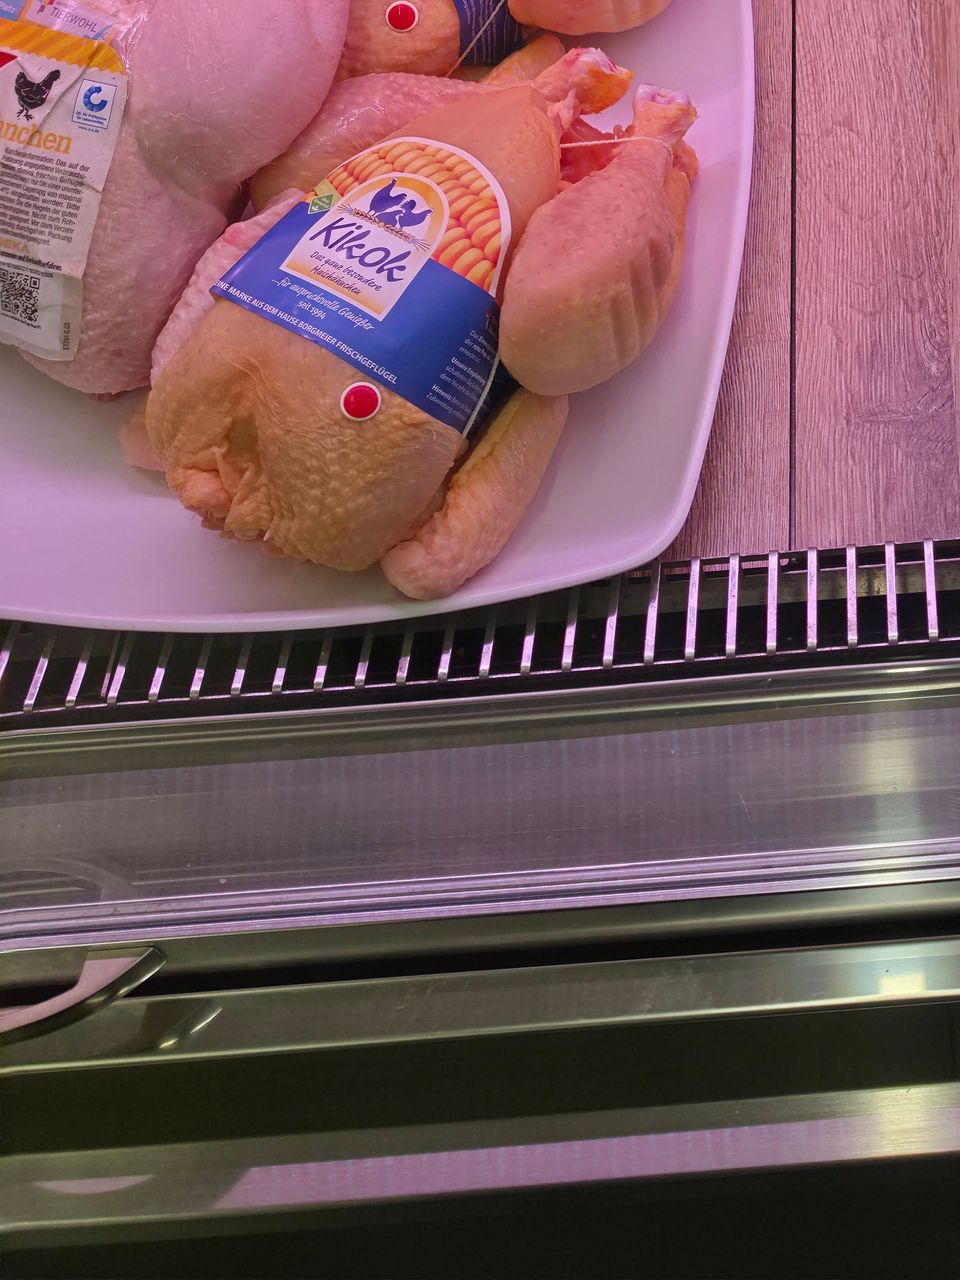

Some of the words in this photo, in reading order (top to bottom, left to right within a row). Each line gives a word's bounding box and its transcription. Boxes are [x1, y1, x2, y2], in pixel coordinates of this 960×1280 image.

[51, 6, 97, 33] TIERWOHL
[24, 161, 55, 173] angegebene
[56, 159, 67, 167] Das
[68, 162, 79, 170] auf
[79, 164, 90, 172] der
[22, 184, 46, 197] Lagerung
[58, 193, 82, 204] maximal
[32, 203, 51, 213] Regeln
[51, 207, 61, 215] der
[61, 210, 78, 219] guten
[66, 202, 80, 211] Bitte
[31, 219, 39, 227] Vor
[40, 221, 53, 230] dem
[53, 223, 74, 234] Verzehr
[32, 211, 47, 220] Nicht
[48, 215, 61, 223] zum
[61, 217, 76, 226] Roh-
[47, 230, 72, 243] Packung
[310, 251, 323, 262] Das
[321, 257, 344, 270] ganz
[343, 265, 382, 291] besondere
[310, 266, 362, 295] Maishähnchen
[290, 281, 340, 312] anspruchsvolle
[338, 307, 375, 332] Genießer
[297, 300, 311, 311] seit
[310, 306, 326, 320] 1994
[228, 286, 252, 304] MARKE
[251, 298, 265, 309] AUS
[263, 304, 279, 316] DEM
[276, 310, 300, 326] HAUSE
[298, 320, 338, 346] BORGMEIER
[335, 341, 398, 385] FRISCHGEFLÜGEL
[451, 356, 470, 372] Unsere
